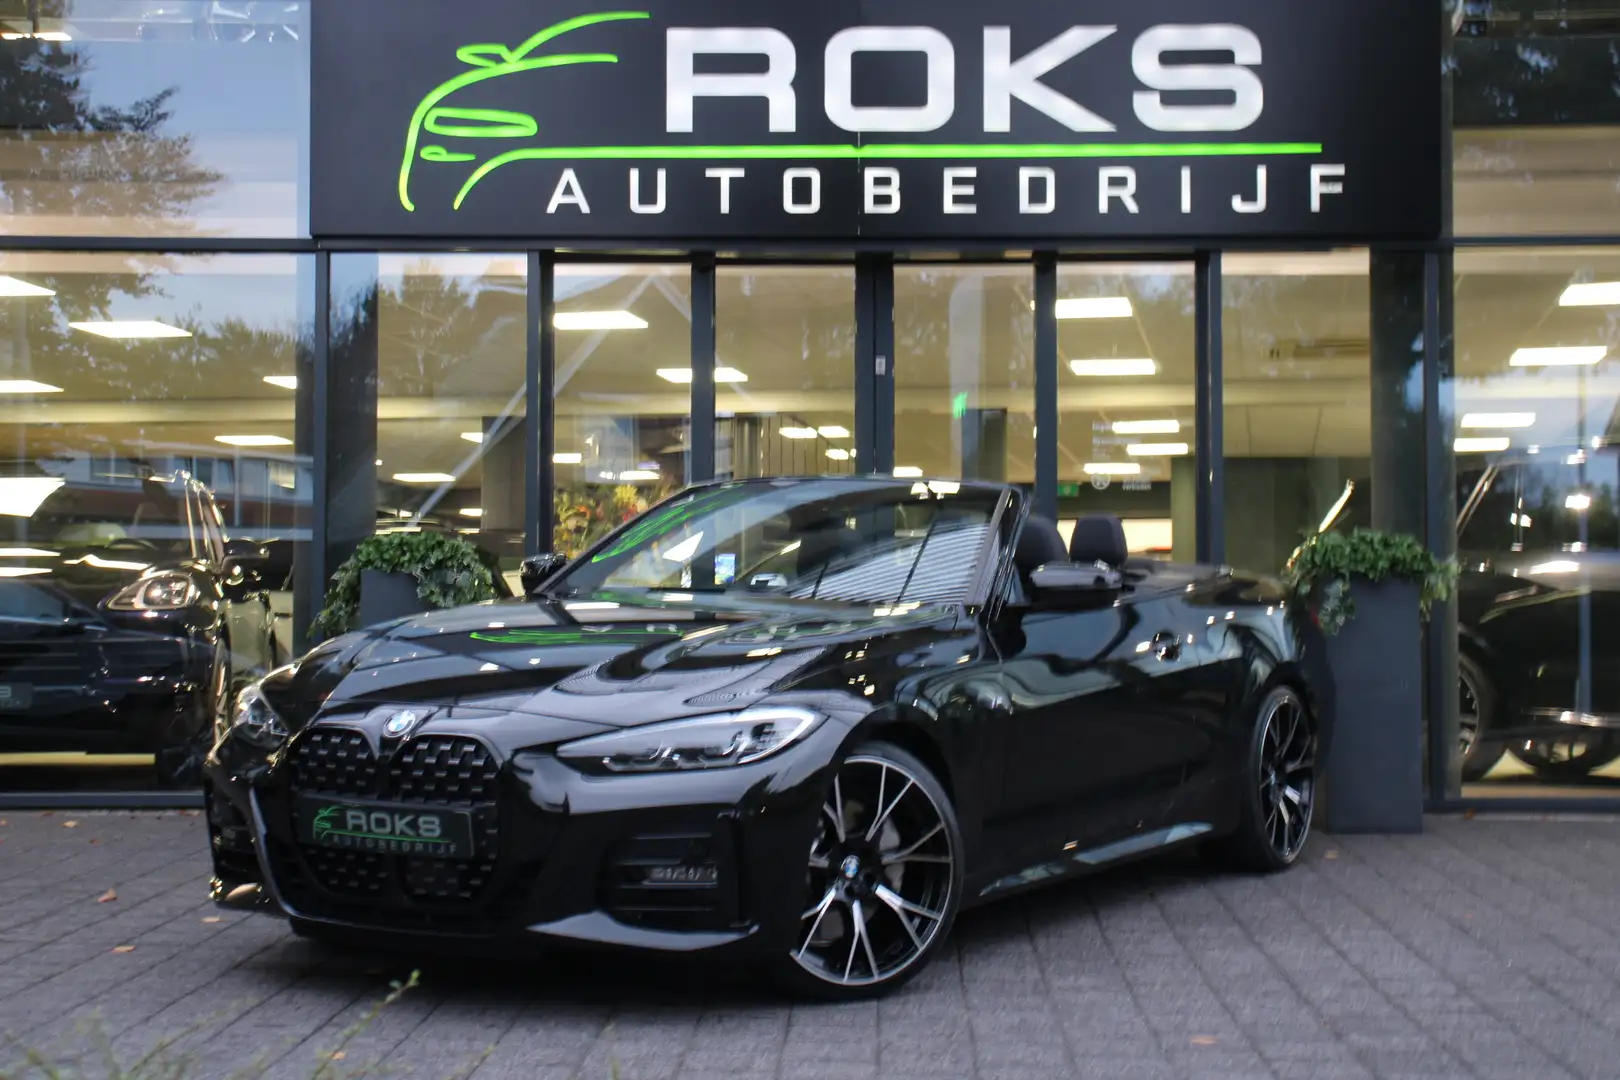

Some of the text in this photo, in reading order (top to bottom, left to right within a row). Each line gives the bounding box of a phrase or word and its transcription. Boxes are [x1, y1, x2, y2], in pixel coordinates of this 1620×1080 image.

[665, 23, 1264, 133] ROKS
[546, 164, 1346, 215] AUTOBEDRIJF
[346, 810, 441, 837] ROKS
[333, 835, 457, 854] AUTOBEDRIJF
